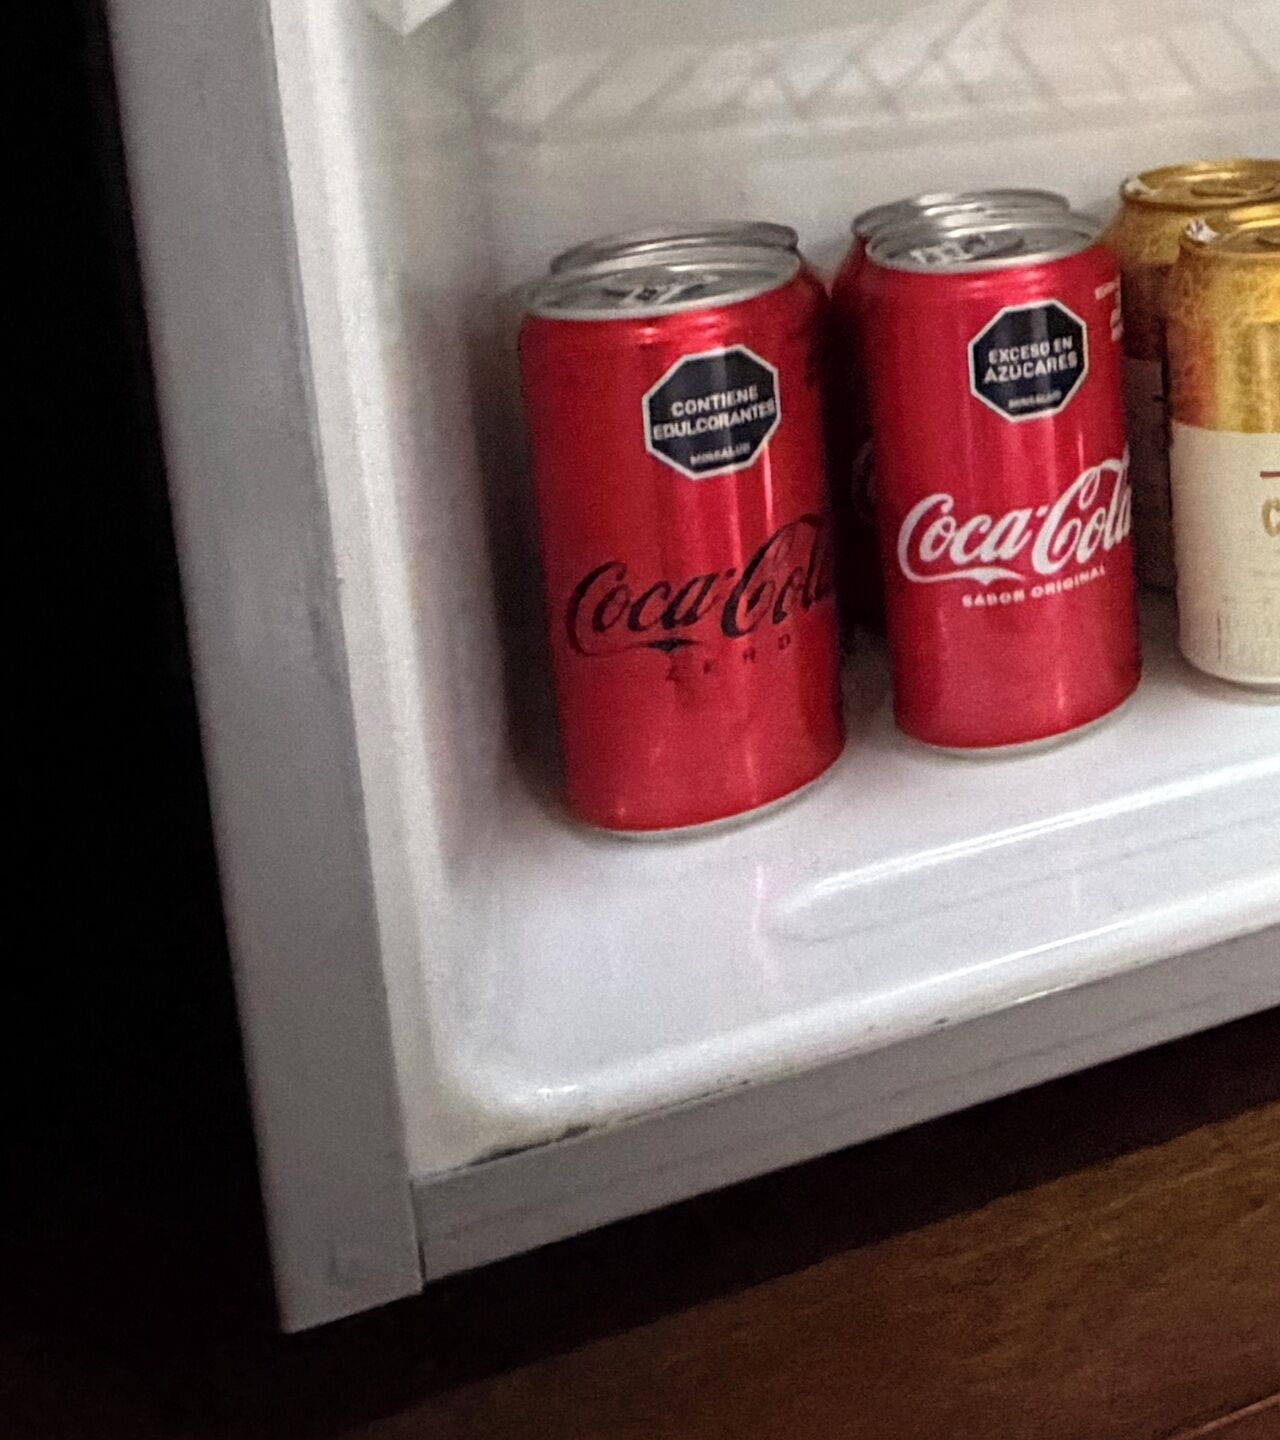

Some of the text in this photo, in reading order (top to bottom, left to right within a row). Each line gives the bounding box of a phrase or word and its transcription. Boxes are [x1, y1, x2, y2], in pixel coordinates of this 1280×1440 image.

[987, 335, 1075, 365] EXCESO EN
[652, 398, 777, 441] EDULCORANTES
[670, 384, 760, 419] CONTIENE
[961, 563, 1106, 608] SABOR ORIGINAL
